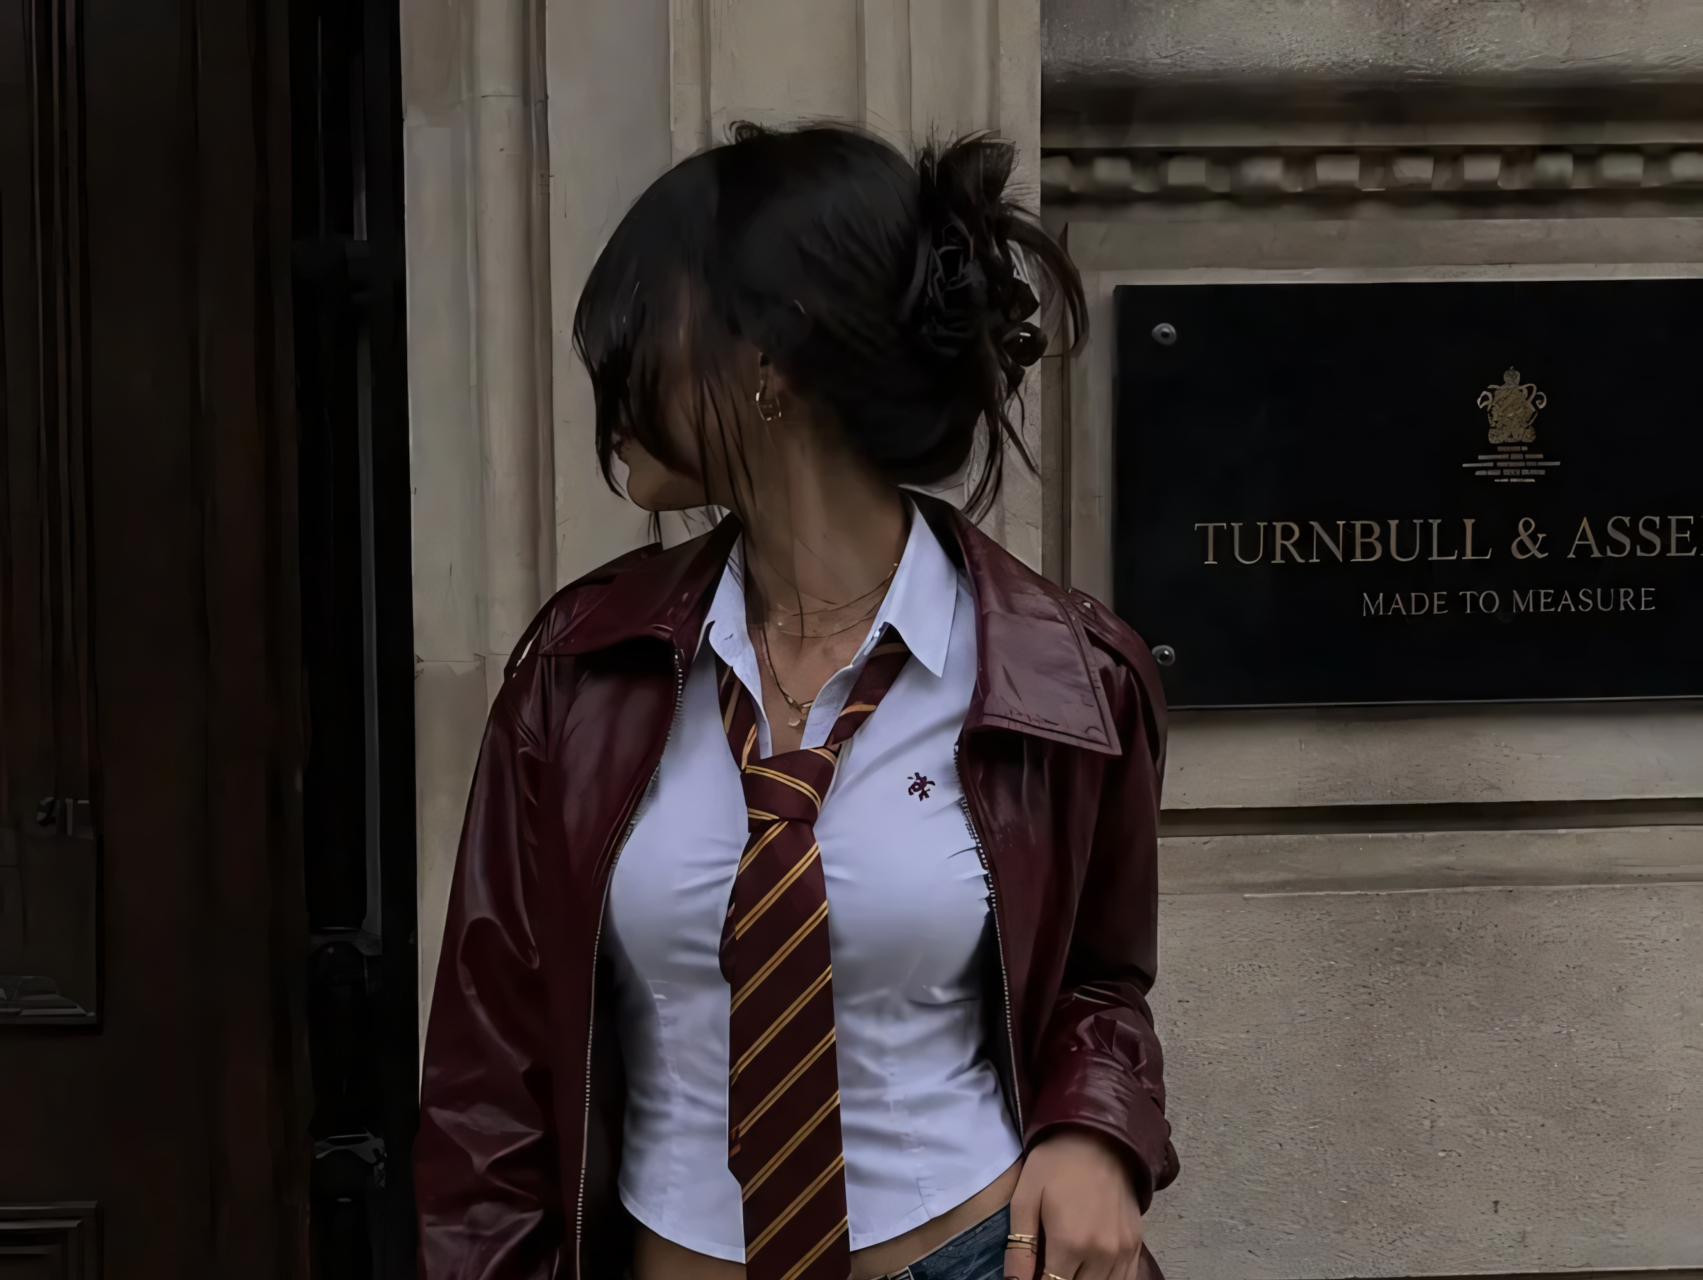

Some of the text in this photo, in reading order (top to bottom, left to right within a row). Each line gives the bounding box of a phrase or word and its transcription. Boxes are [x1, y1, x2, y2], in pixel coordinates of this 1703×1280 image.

[1194, 515, 1703, 565] TURNBULL & ASSE
[1362, 587, 1656, 617] MADE TO MEASURE
